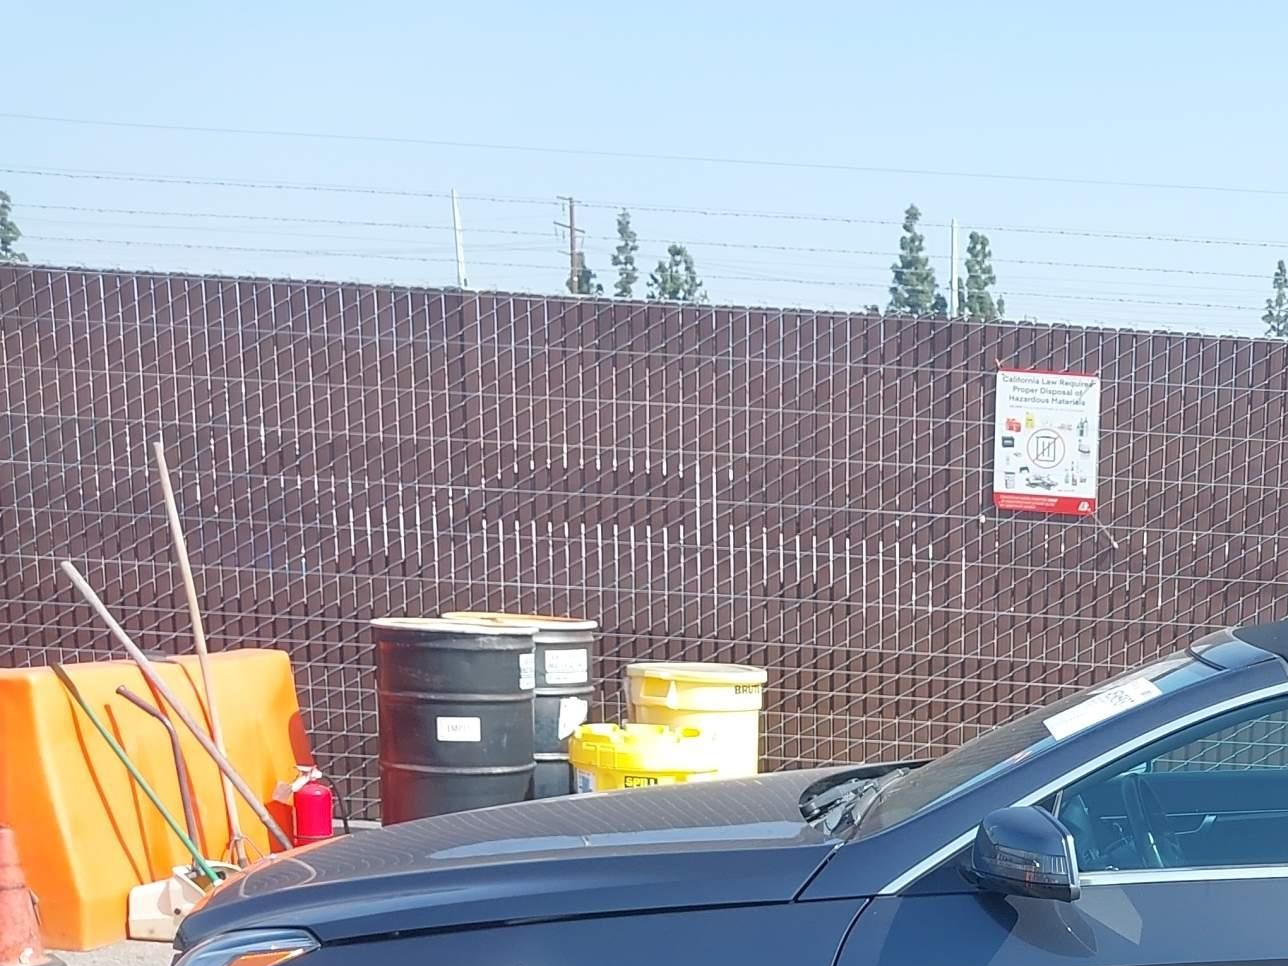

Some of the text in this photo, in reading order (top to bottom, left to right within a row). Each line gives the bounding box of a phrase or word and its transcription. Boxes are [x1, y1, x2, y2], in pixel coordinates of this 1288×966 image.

[1002, 376, 1040, 385] California
[1042, 377, 1057, 385] Law
[1013, 386, 1038, 395] Proper
[1040, 387, 1073, 397] Disposal
[1009, 395, 1086, 406] Hazardous Materials
